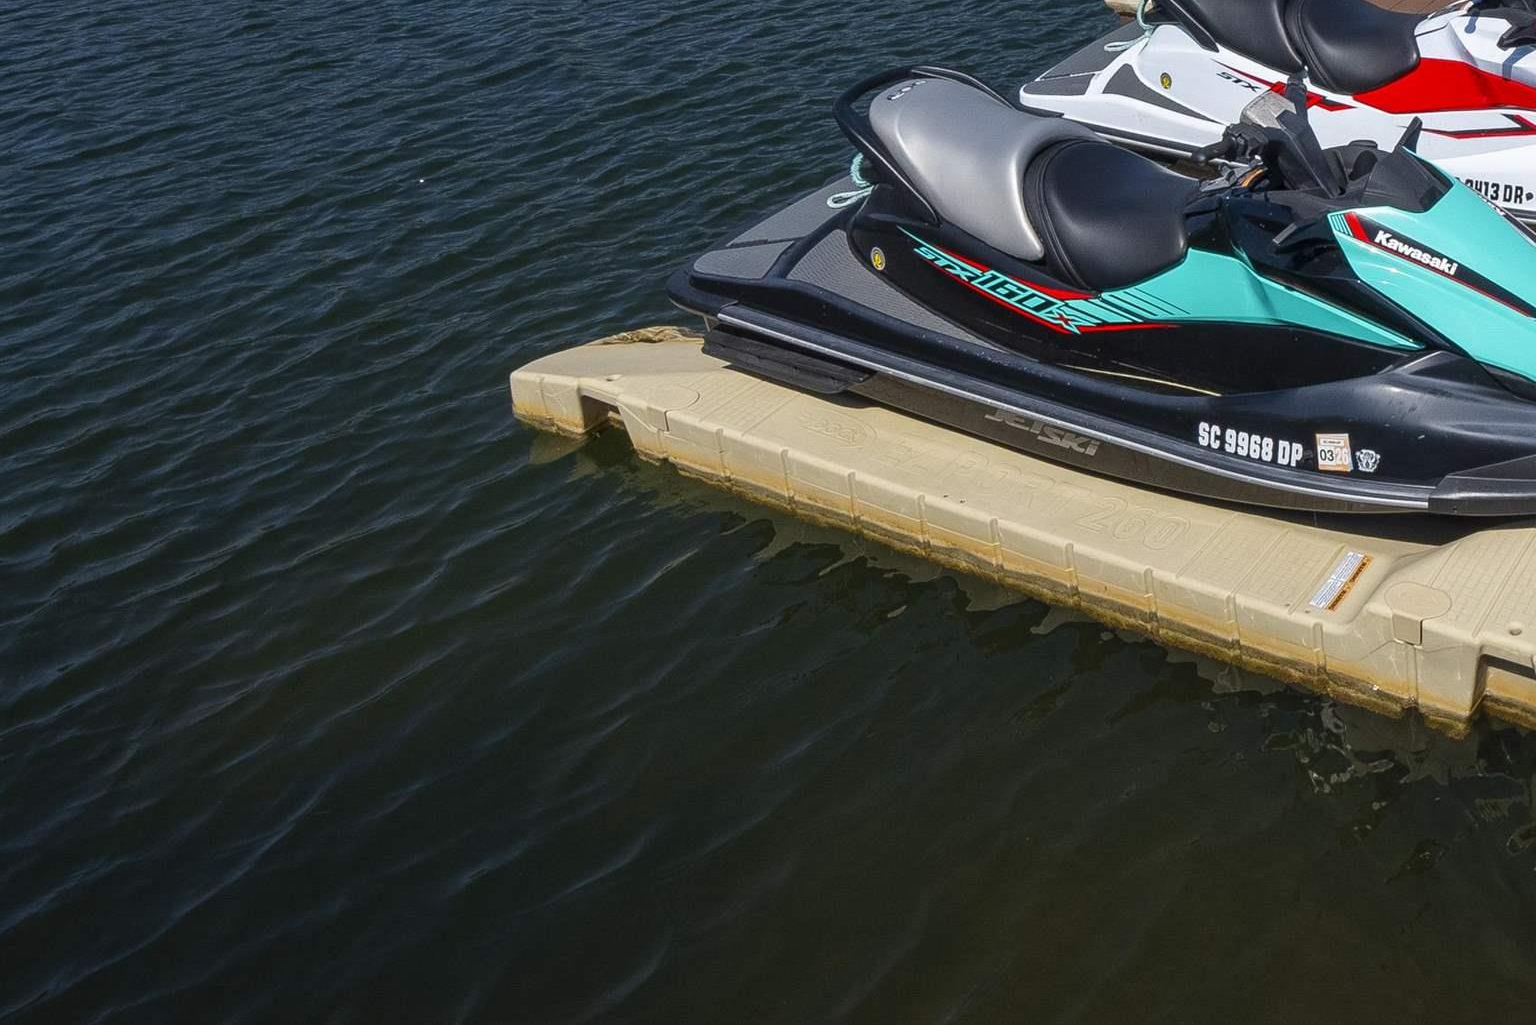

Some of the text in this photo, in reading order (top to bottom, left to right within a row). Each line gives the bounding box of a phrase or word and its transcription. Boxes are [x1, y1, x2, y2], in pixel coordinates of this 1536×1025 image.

[1216, 72, 1261, 92] STX
[1503, 184, 1524, 204] DR
[1374, 229, 1458, 275] Kawasaki
[1198, 421, 1303, 467] SC 9968 DP
[1320, 449, 1334, 461] 03
[1072, 495, 1192, 550] 260
